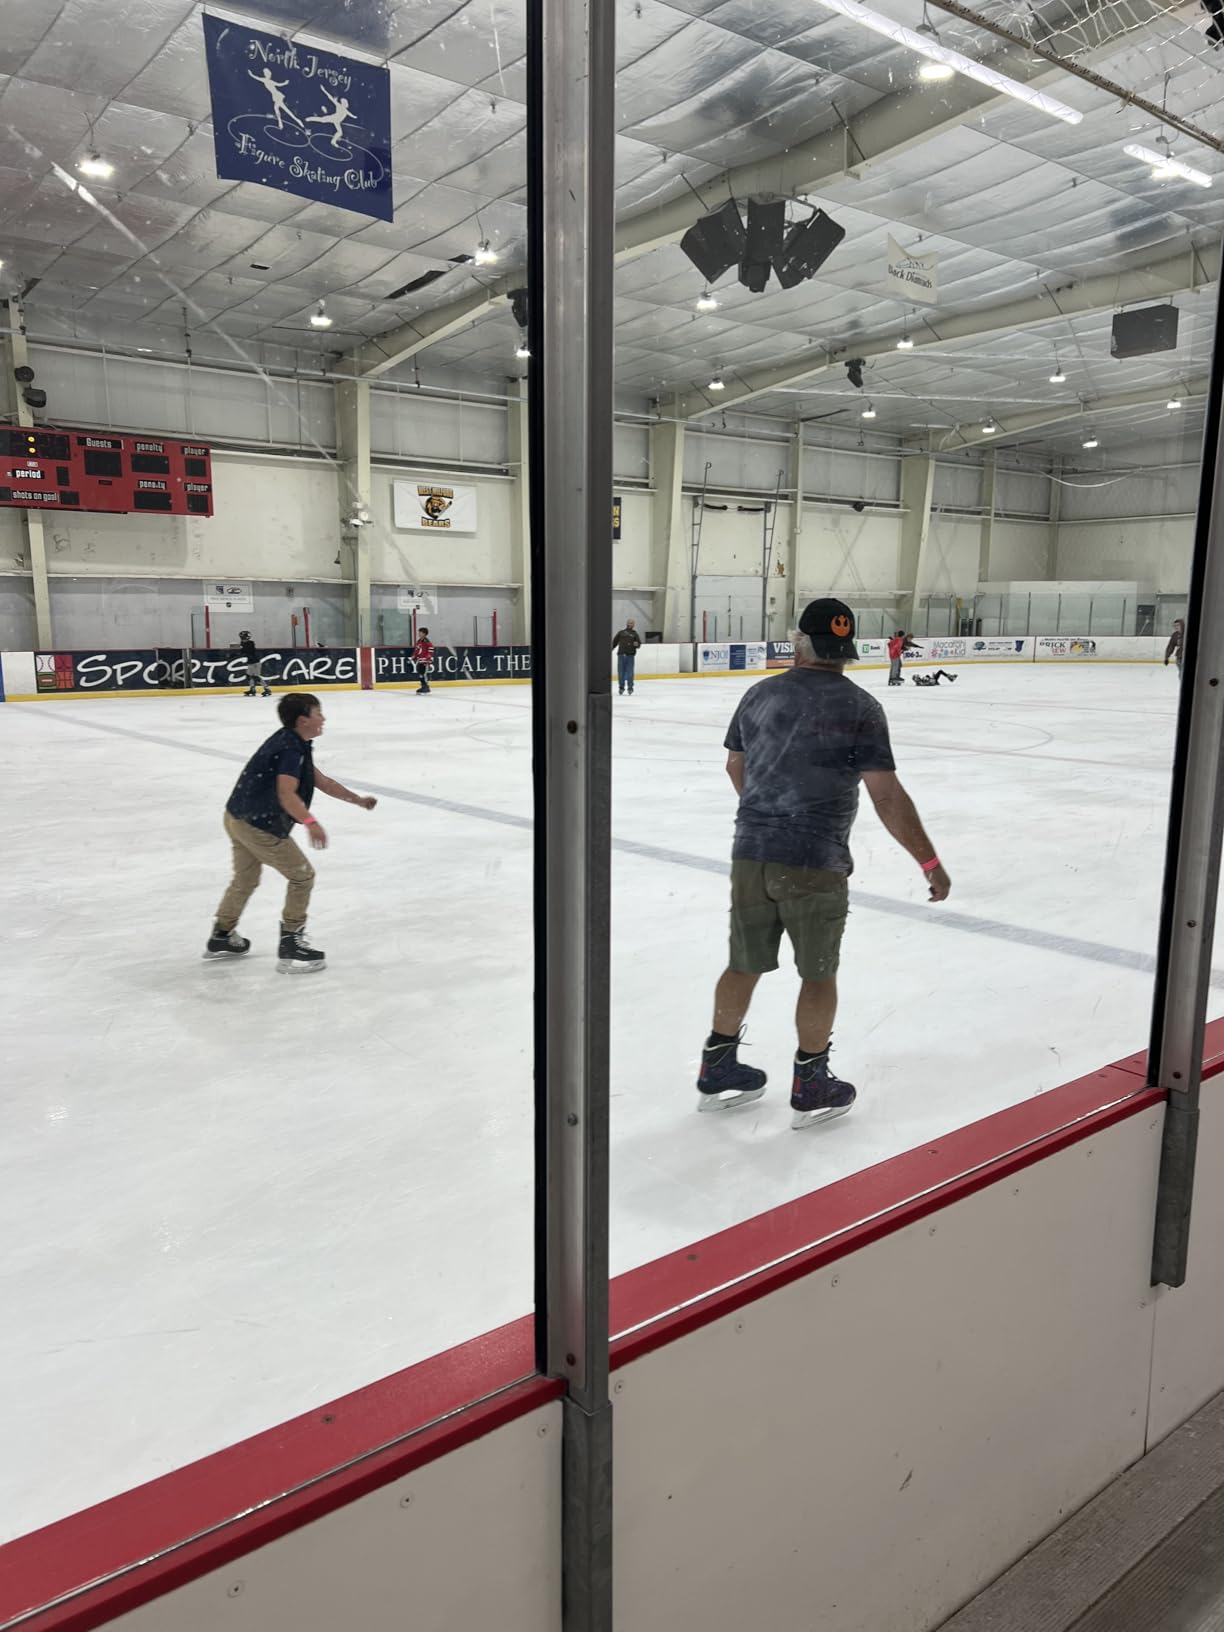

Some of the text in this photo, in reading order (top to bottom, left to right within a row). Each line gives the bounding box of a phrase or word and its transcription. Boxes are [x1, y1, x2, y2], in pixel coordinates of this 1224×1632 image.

[249, 39, 352, 92] North Jersey
[234, 132, 378, 192] Figure Skating Club
[86, 437, 112, 449] Guests
[136, 442, 163, 453] penalty
[184, 447, 206, 456] player
[15, 469, 42, 479] period
[186, 483, 209, 492] player
[12, 490, 57, 502] shots on goal
[376, 655, 487, 675] PHYSICAL
